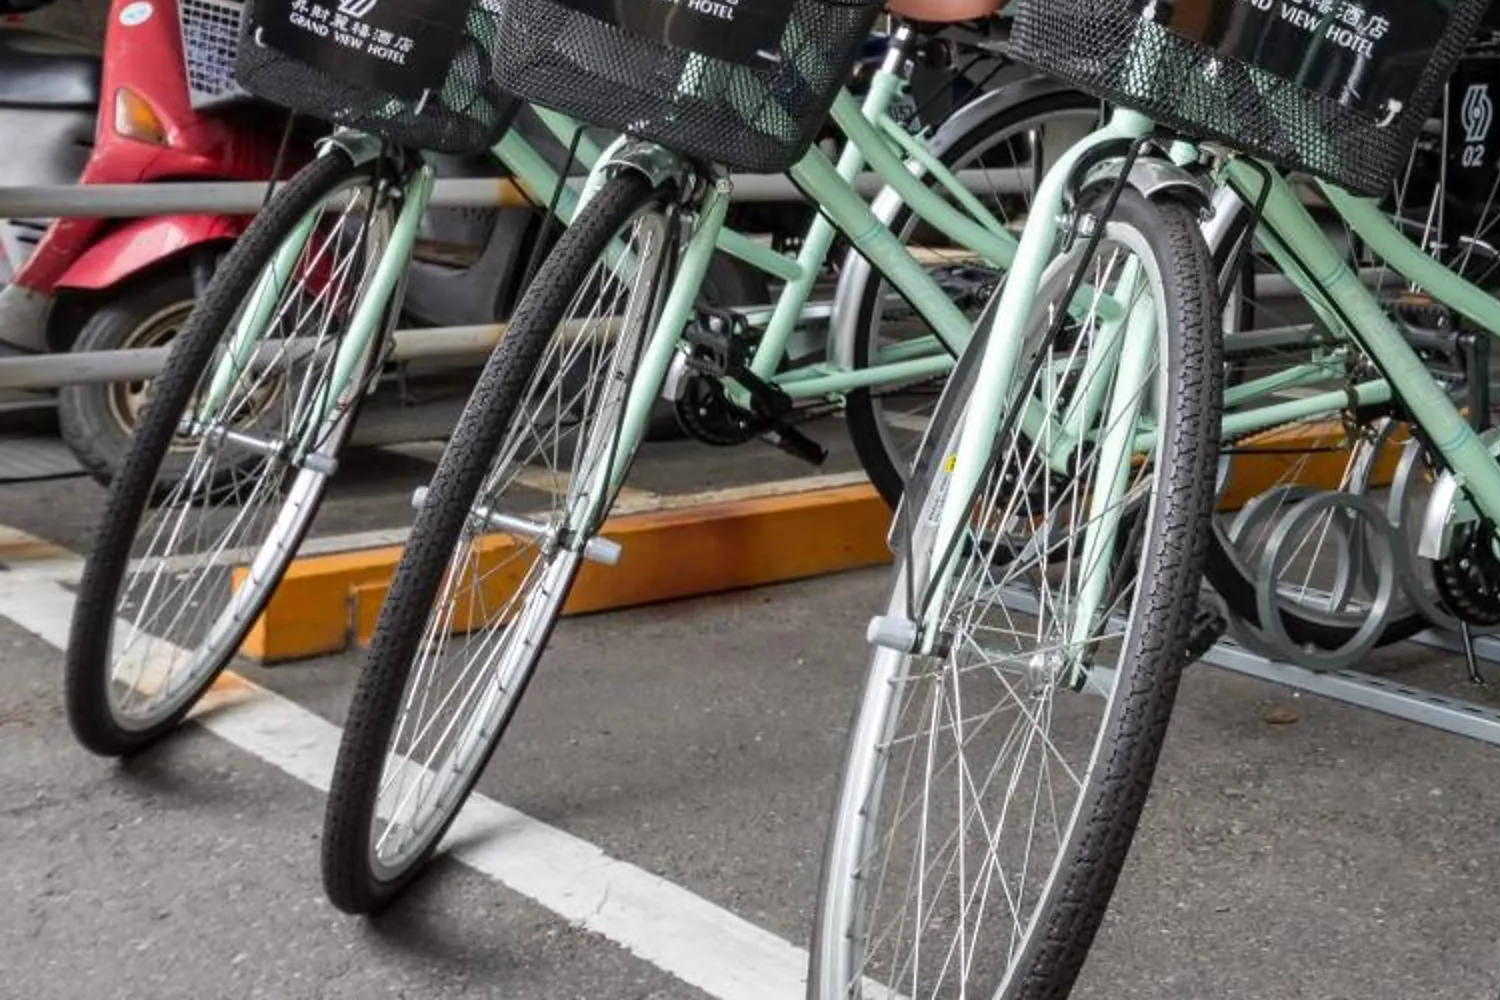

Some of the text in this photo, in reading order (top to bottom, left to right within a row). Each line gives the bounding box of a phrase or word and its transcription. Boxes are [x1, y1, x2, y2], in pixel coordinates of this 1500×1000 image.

[289, 11, 406, 65] GRAND VIEW HOTEL
[1281, 3, 1321, 32] VIEW
[1325, 24, 1374, 58] HOTEL
[1461, 144, 1486, 168] 02
